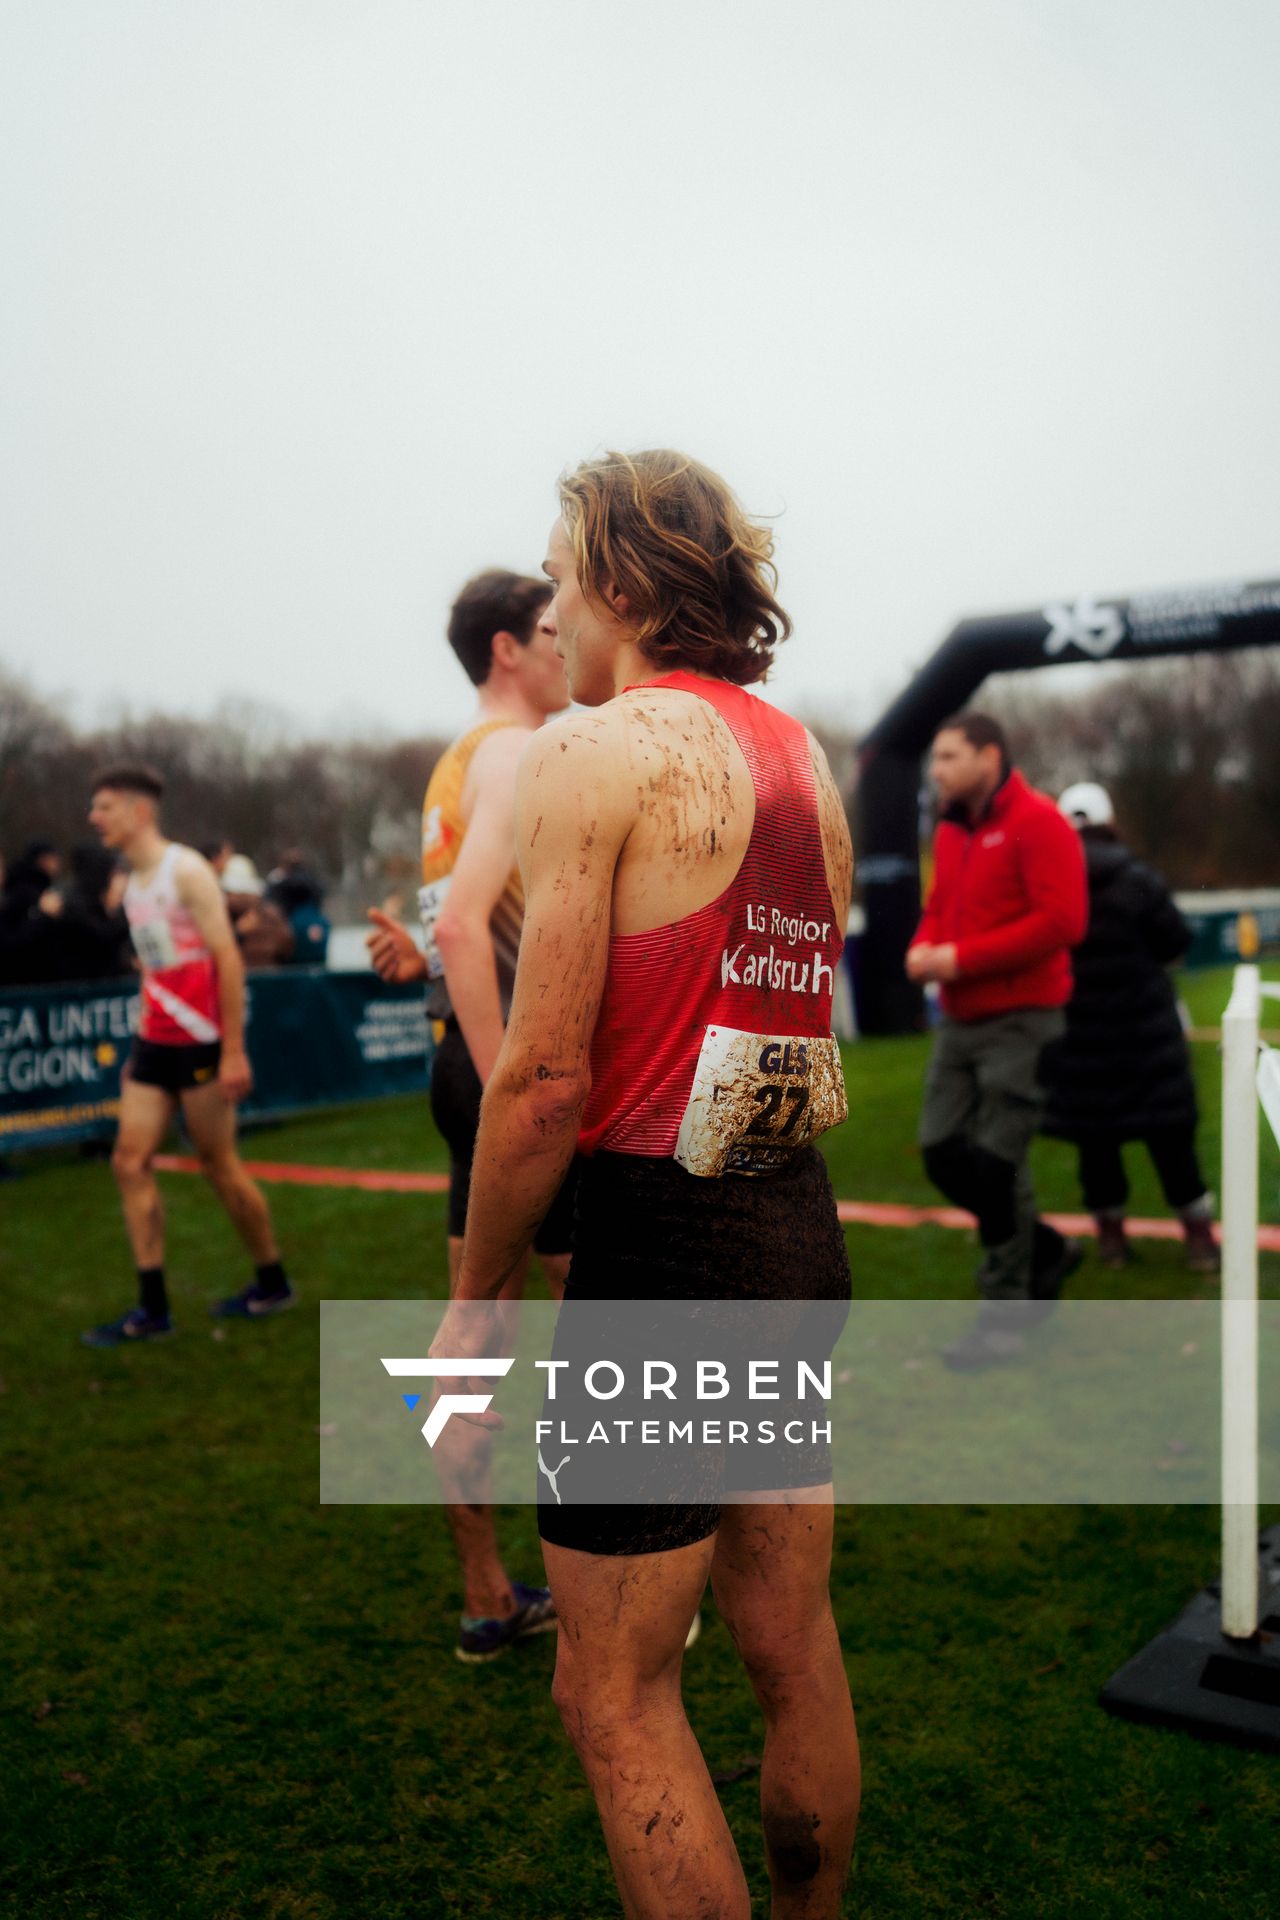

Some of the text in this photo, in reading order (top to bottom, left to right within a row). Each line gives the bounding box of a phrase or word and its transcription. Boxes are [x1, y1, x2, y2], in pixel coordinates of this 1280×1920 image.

[747, 903, 766, 933] LG
[759, 1043, 808, 1076] GLS
[744, 1085, 810, 1137] 27
